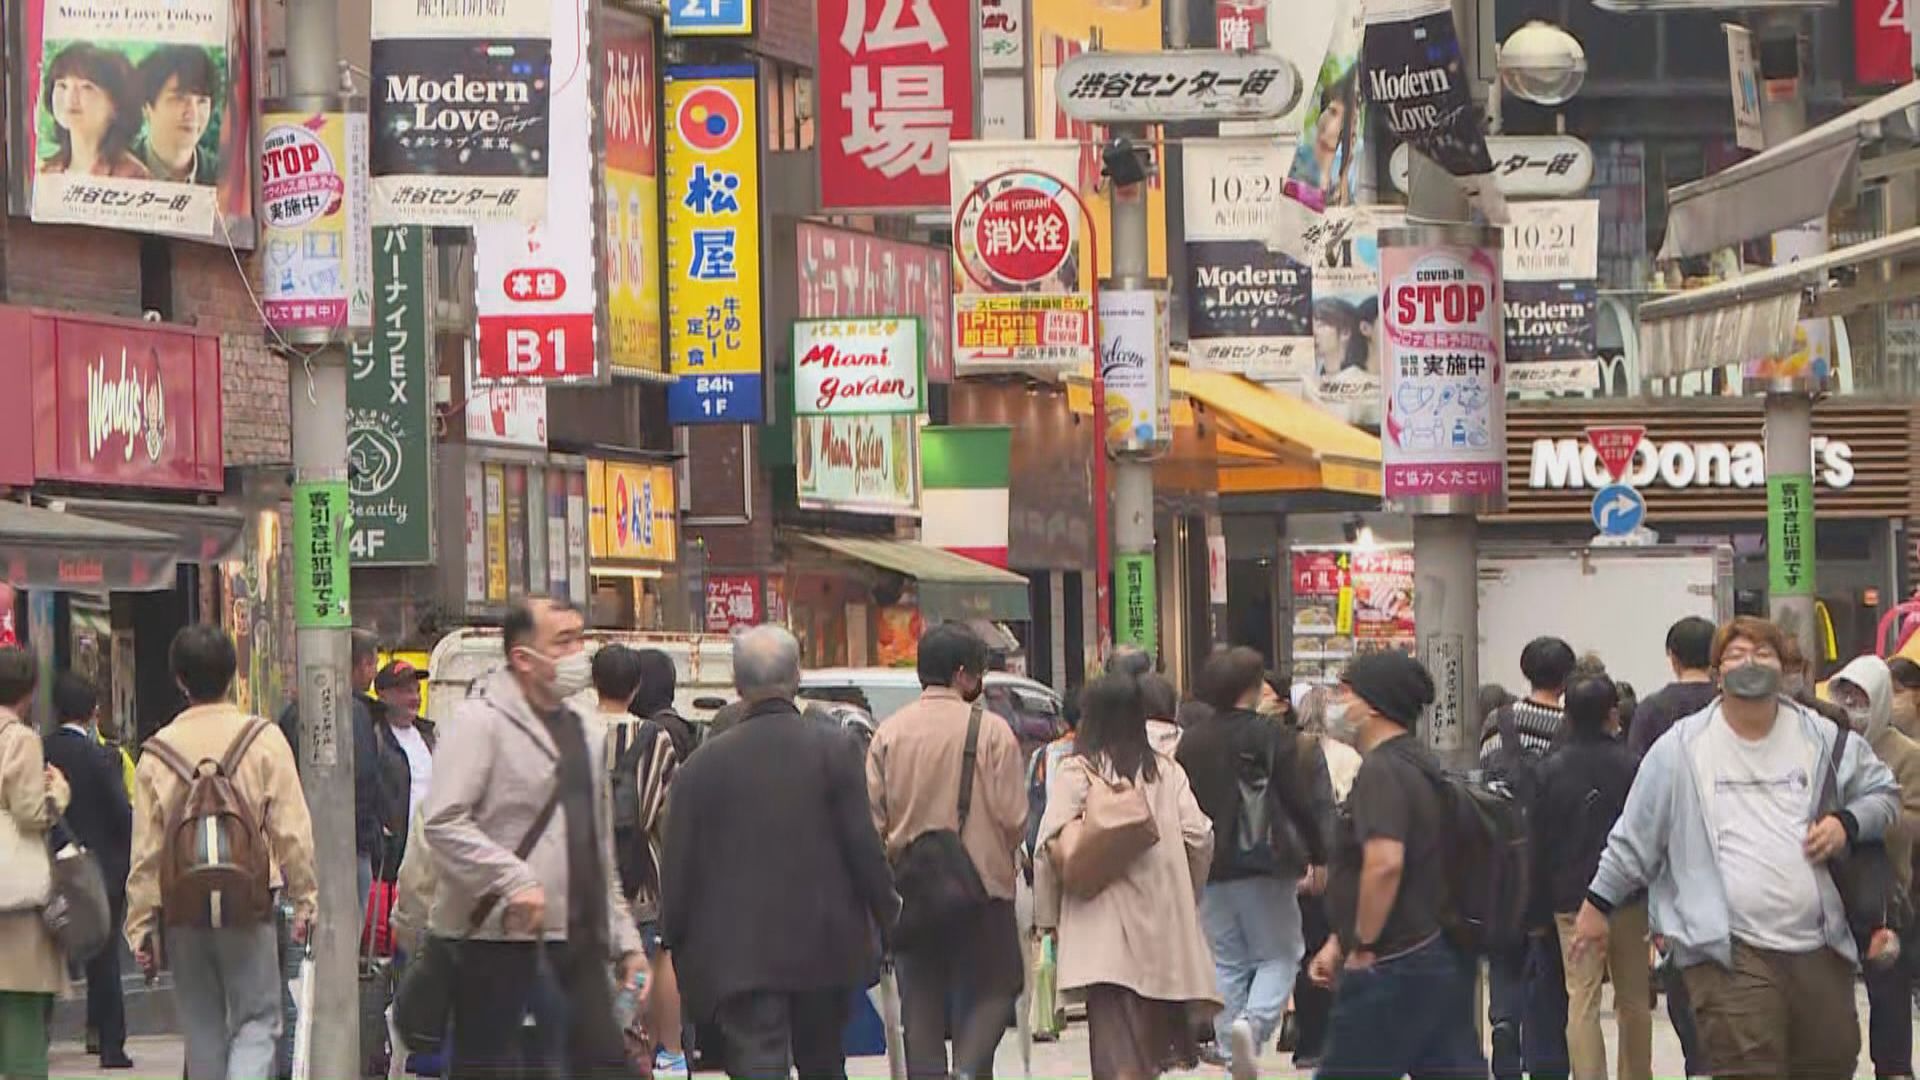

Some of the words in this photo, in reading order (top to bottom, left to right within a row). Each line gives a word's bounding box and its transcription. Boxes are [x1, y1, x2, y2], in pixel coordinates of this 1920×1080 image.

[385, 73, 528, 103] Modern
[1068, 68, 1280, 99] 渋谷センター街
[1369, 64, 1451, 101] Modern
[413, 103, 500, 131] Love
[1387, 103, 1440, 132] Love
[270, 194, 320, 222] 実施中
[684, 165, 740, 279] 松屋
[983, 212, 1064, 256] 消火栓
[511, 272, 557, 297] 本店
[1197, 267, 1298, 288] Modern
[1416, 268, 1464, 282] COVID-19
[1218, 287, 1279, 307] Love
[1397, 284, 1486, 325] STOP
[723, 297, 741, 351] 牛めし
[1503, 303, 1584, 321] Modern
[706, 305, 721, 359] カレー
[1517, 318, 1568, 336] Love
[506, 328, 566, 373] B1
[687, 318, 705, 367] 定食
[800, 343, 892, 369] Miami
[1423, 354, 1486, 377] 実施中
[696, 378, 734, 394] 24h
[1319, 382, 1381, 397] 渋谷センター
[1529, 438, 1855, 488] McDona's
[1782, 483, 1802, 586] 客引きは犯罪です
[309, 492, 332, 617] 客引きは犯罪です
